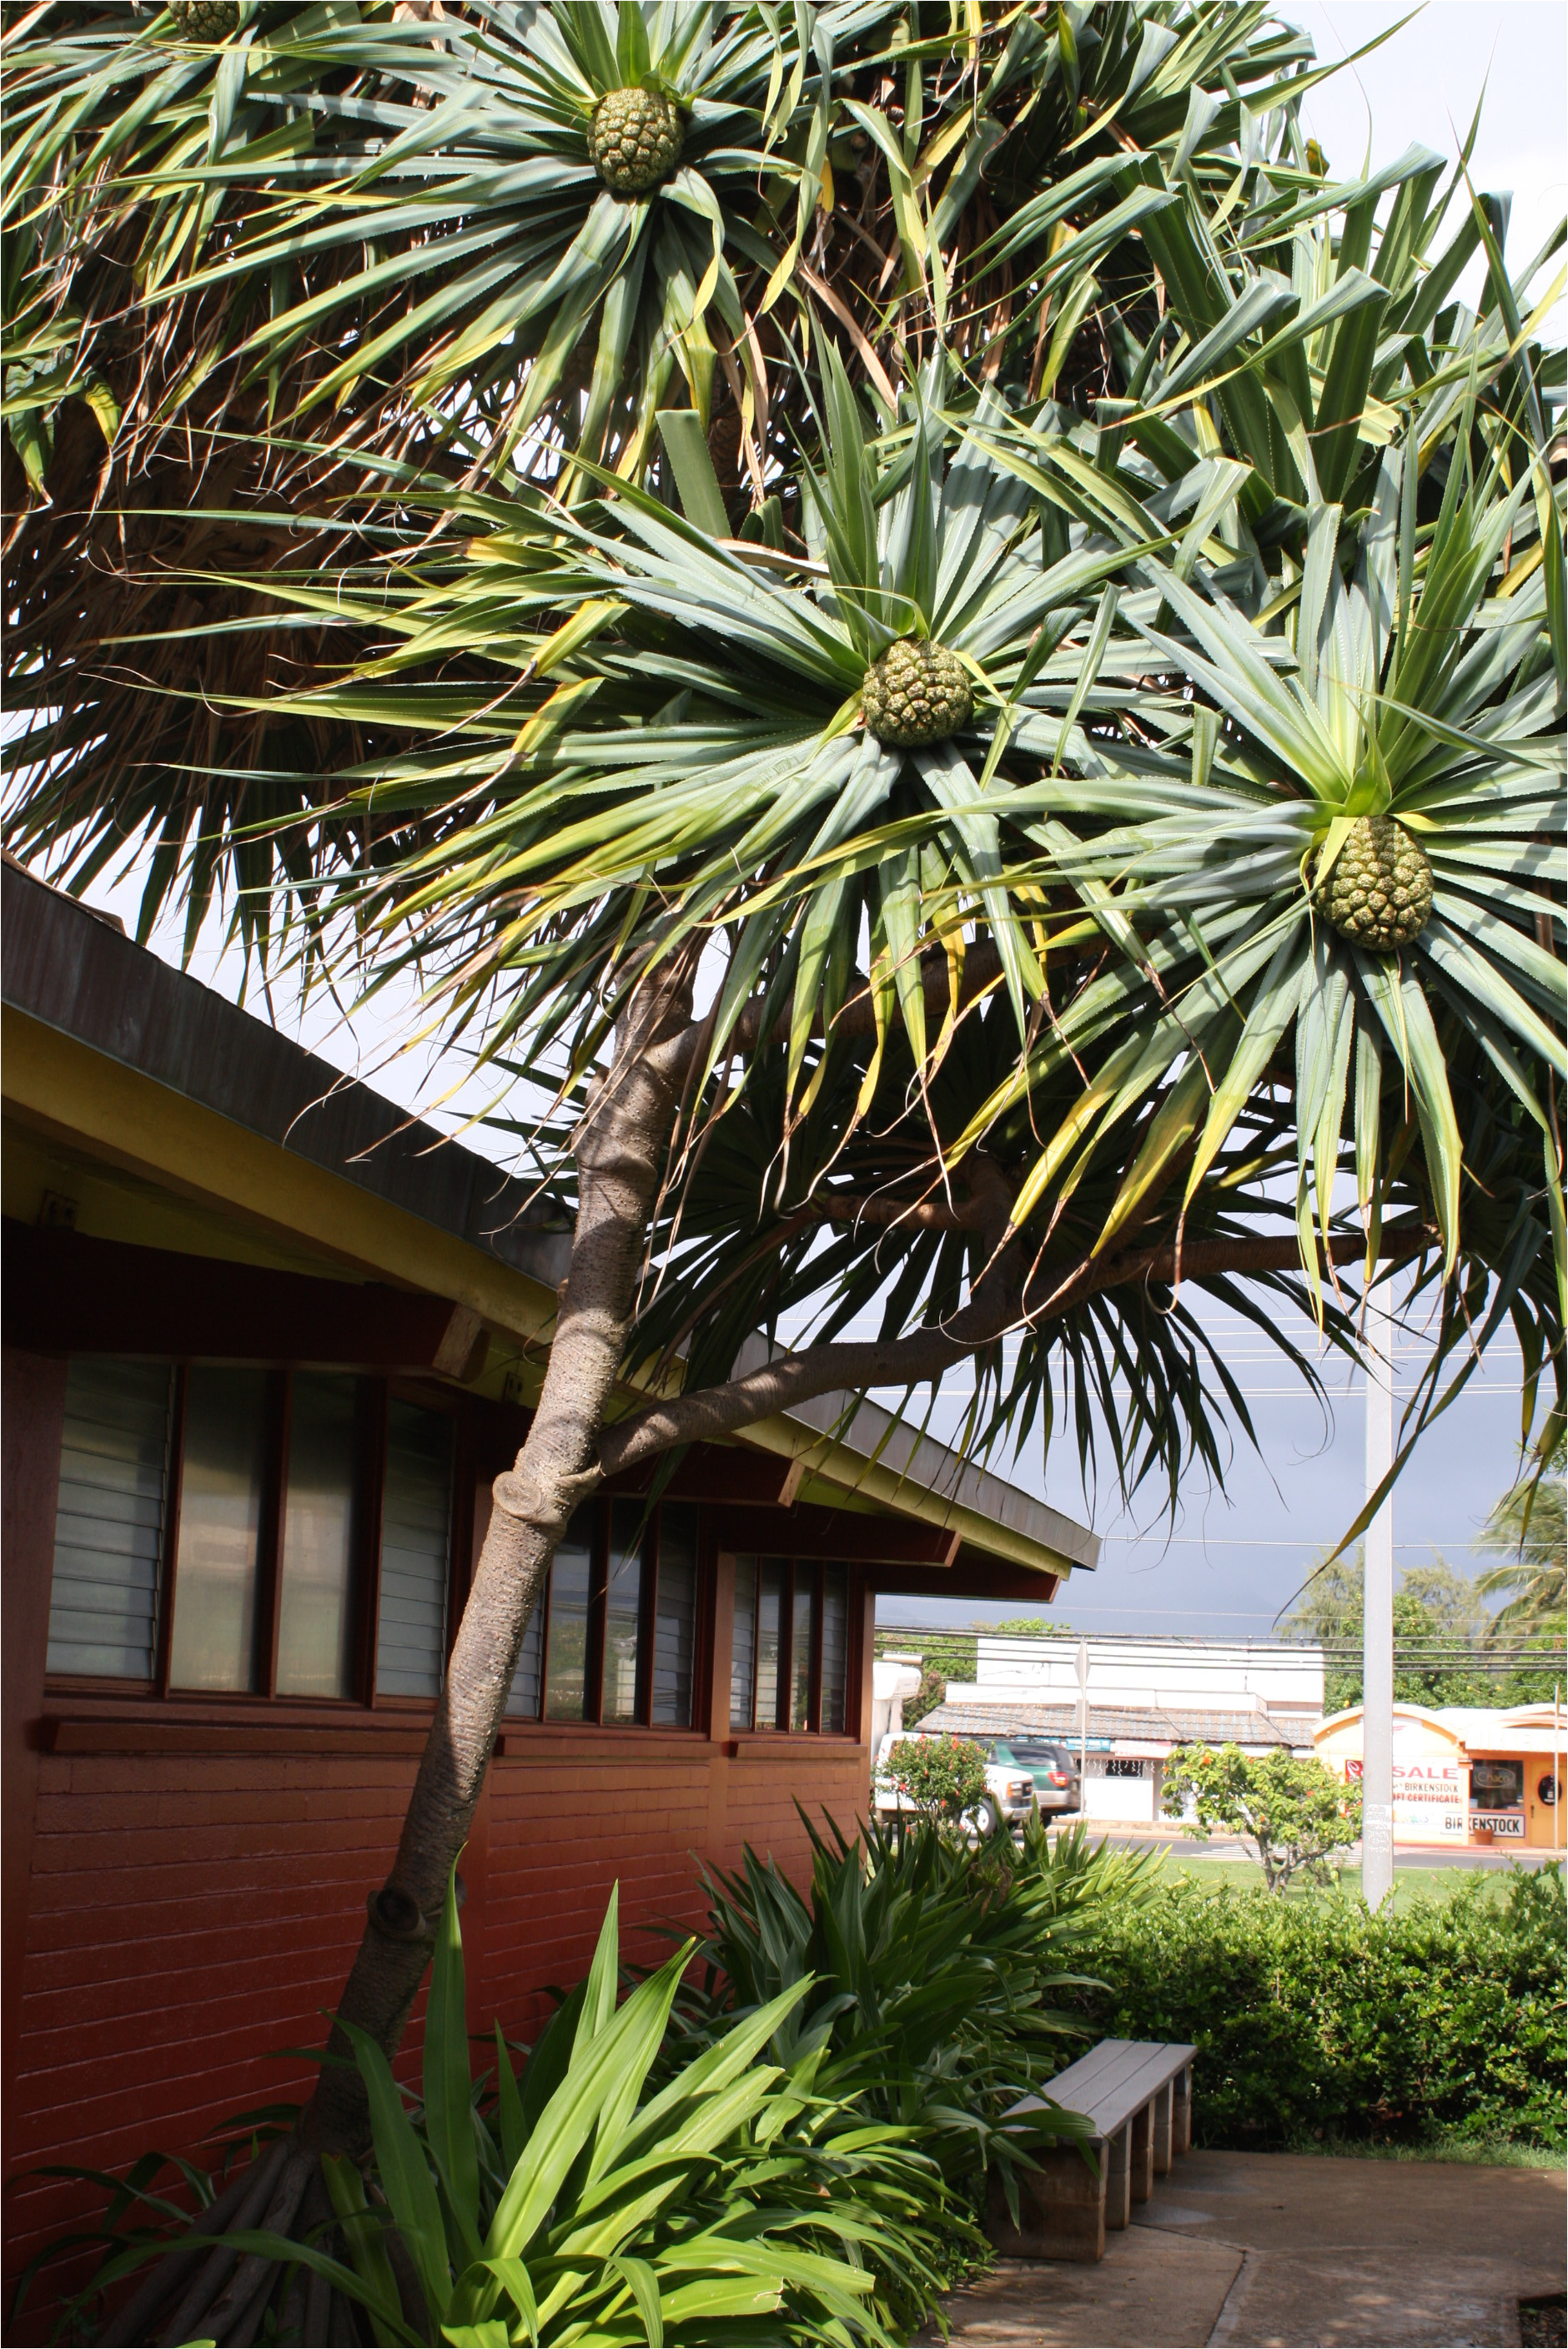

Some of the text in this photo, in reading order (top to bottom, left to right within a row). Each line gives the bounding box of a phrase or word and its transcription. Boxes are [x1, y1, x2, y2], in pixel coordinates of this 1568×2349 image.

[1392, 1766, 1459, 1779] SALE
[1477, 1772, 1510, 1783] Chaco
[1405, 1783, 1459, 1793] BIRKENSTOCK
[1392, 1793, 1405, 1801] IFT
